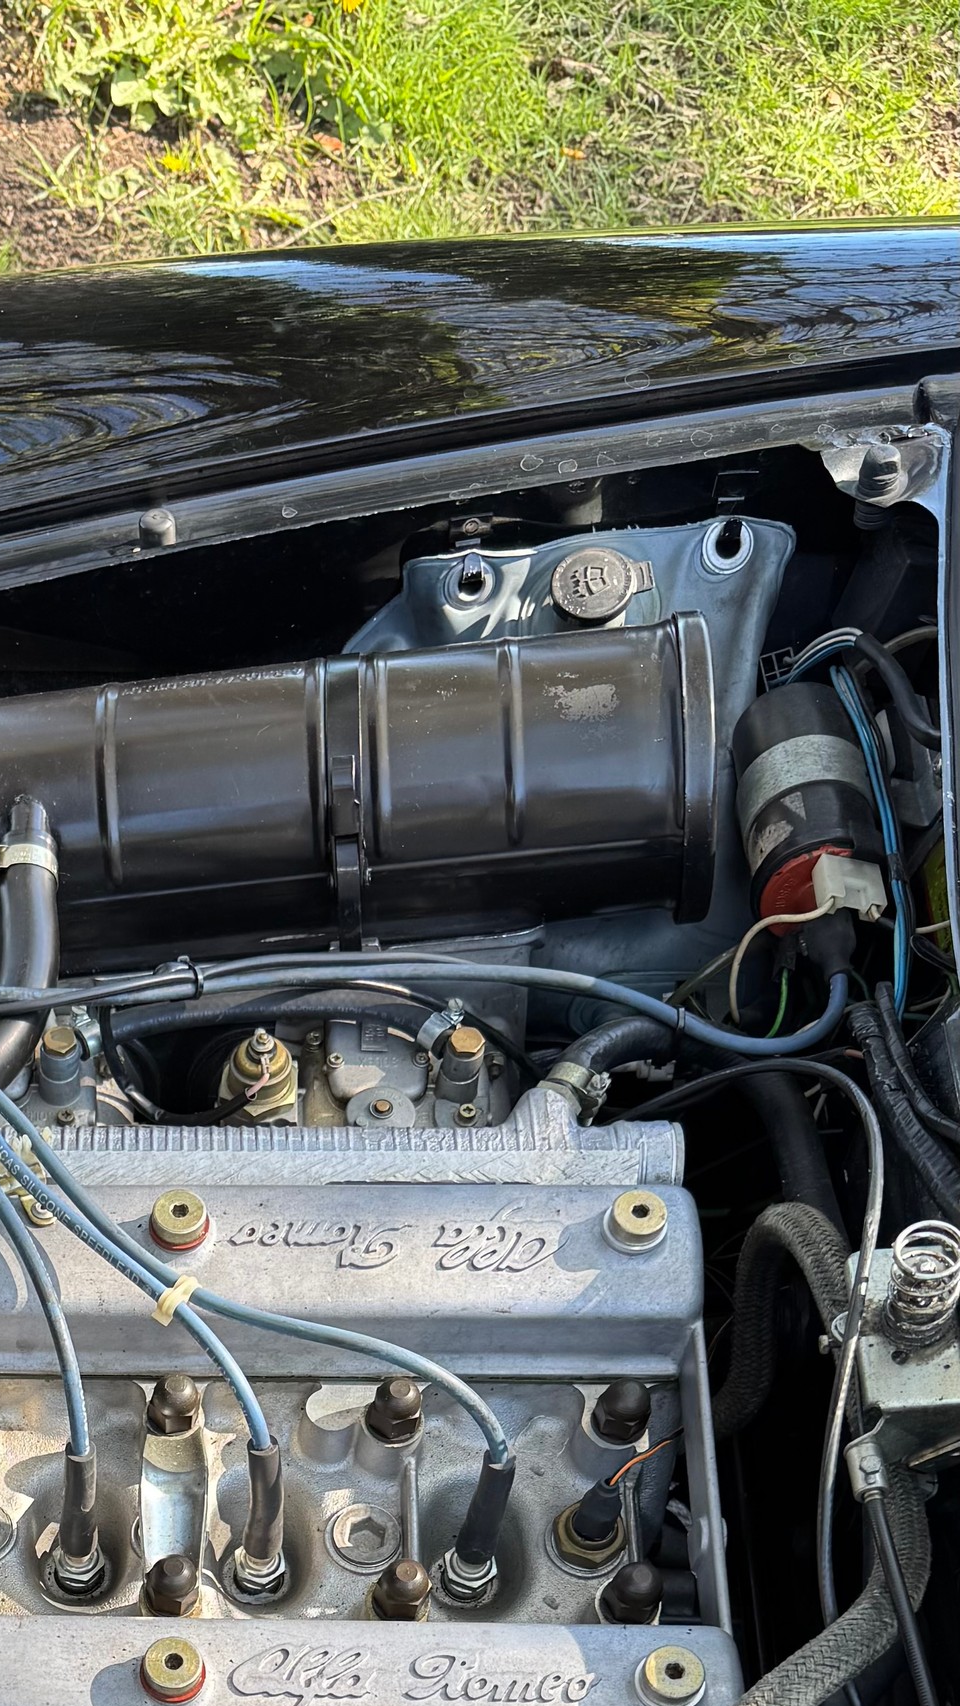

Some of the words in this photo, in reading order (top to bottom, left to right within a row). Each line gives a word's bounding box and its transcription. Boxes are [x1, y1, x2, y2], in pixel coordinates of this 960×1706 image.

[20, 1175, 71, 1227] SILICONE
[73, 1224, 141, 1284] SPEEDLEAD
[227, 1220, 413, 1270] Romeo
[431, 1198, 570, 1272] Alfa
[402, 1648, 601, 1704] Romeo
